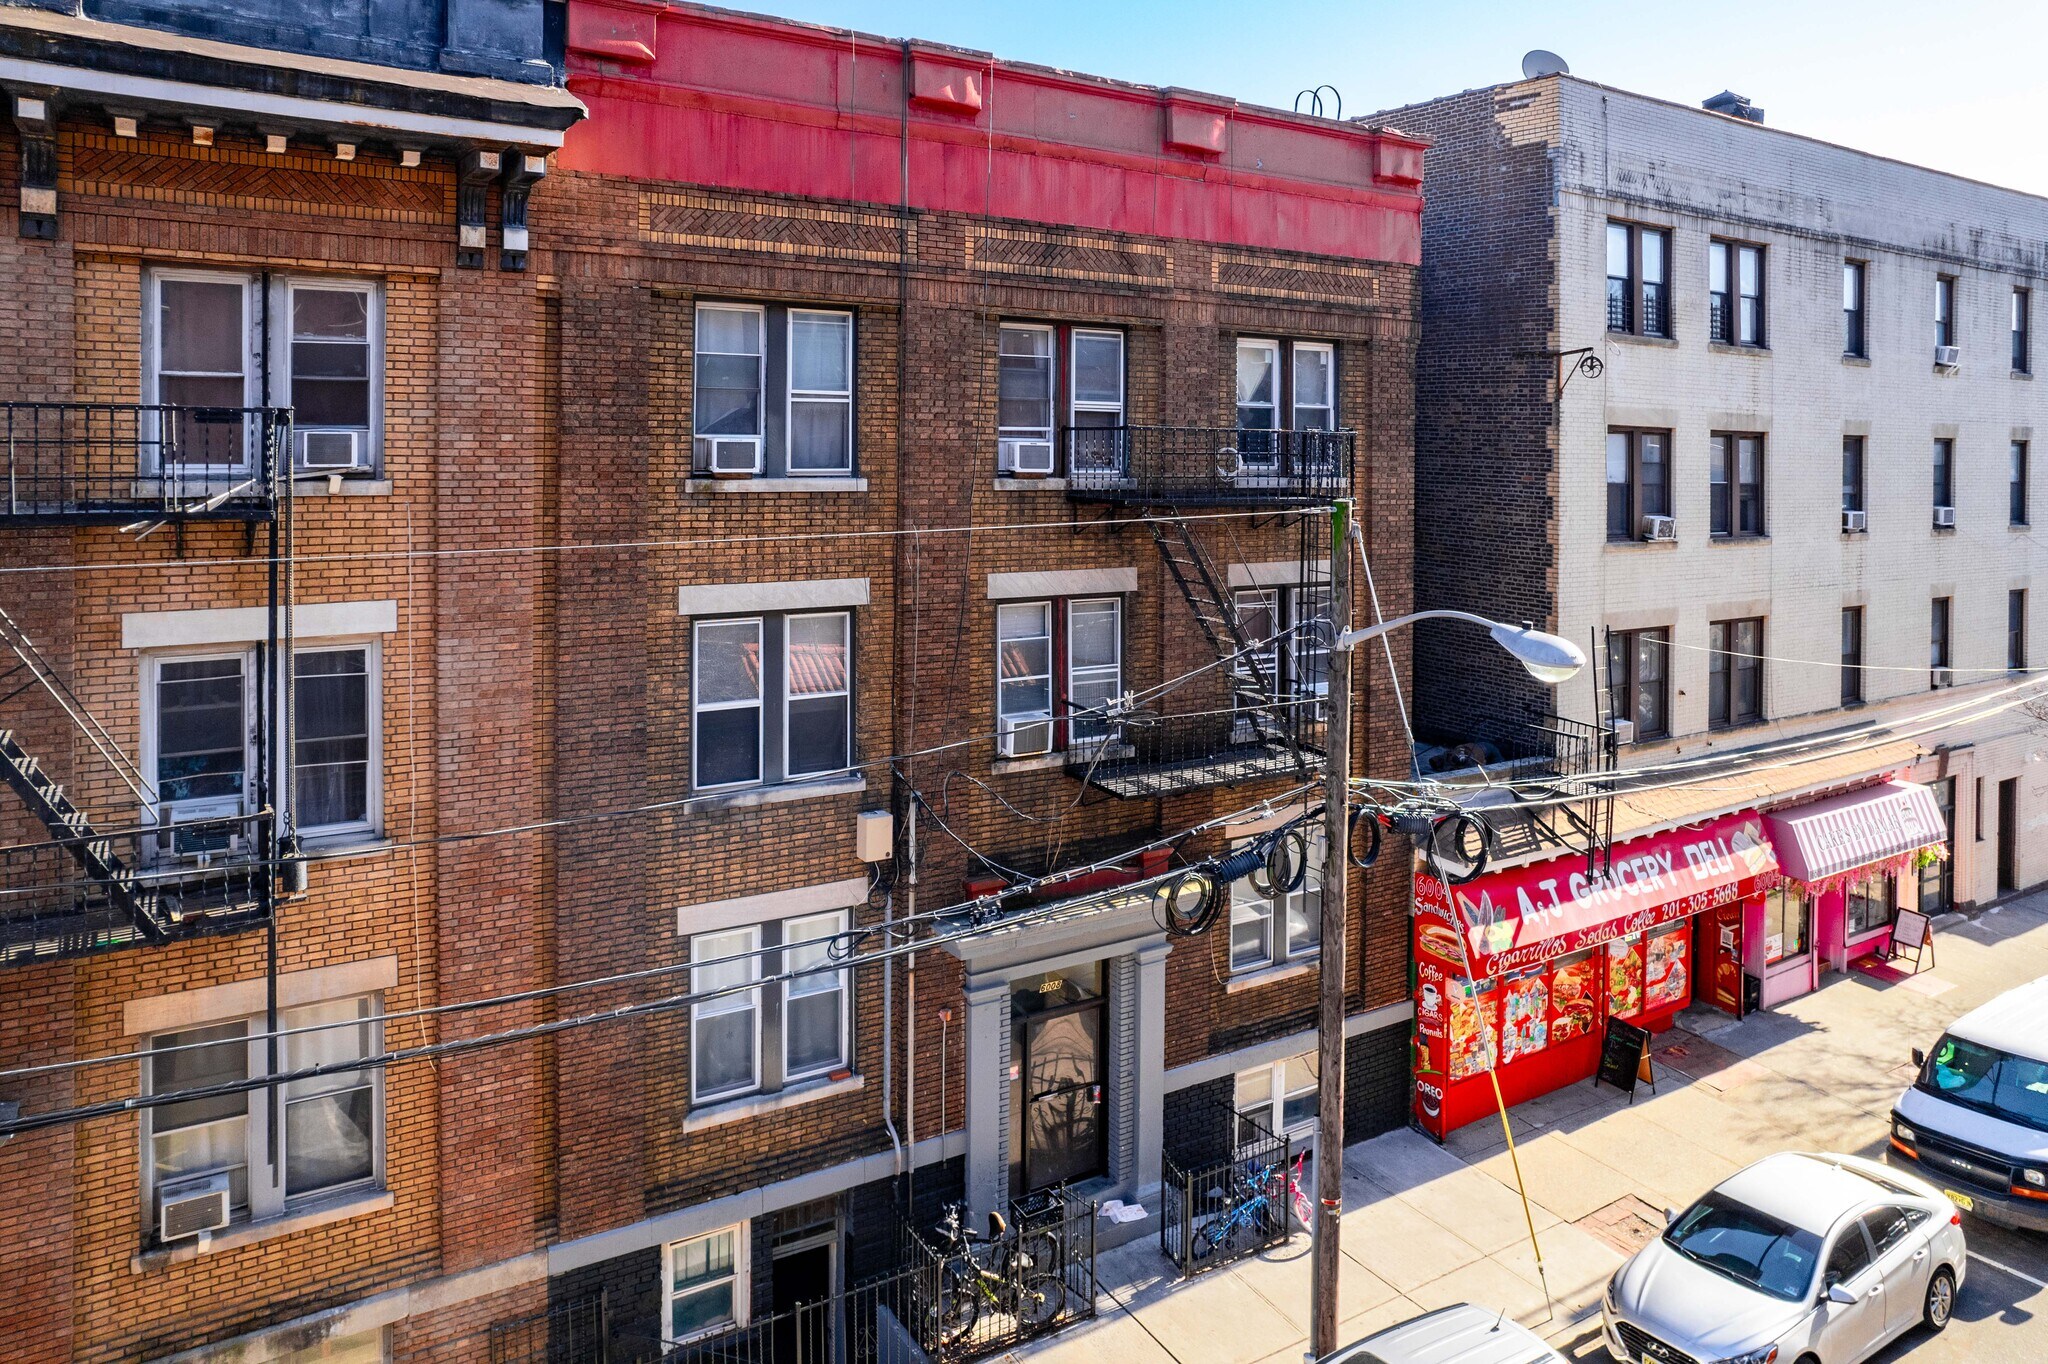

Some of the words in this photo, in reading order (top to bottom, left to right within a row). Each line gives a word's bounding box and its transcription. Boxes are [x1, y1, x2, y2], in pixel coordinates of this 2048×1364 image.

[1851, 822, 1866, 841] BY
[1569, 851, 1678, 909] GROCERY
[1684, 838, 1735, 880] DELI
[1486, 934, 1567, 976] Cigarrillos
[1574, 920, 1618, 950] Sodas
[1623, 908, 1656, 934] Coffee
[1418, 961, 1443, 982] Coffee
[1417, 1008, 1443, 1022] CIGARS
[1419, 1023, 1443, 1039] Peanuts
[1416, 1079, 1443, 1101] OREO
